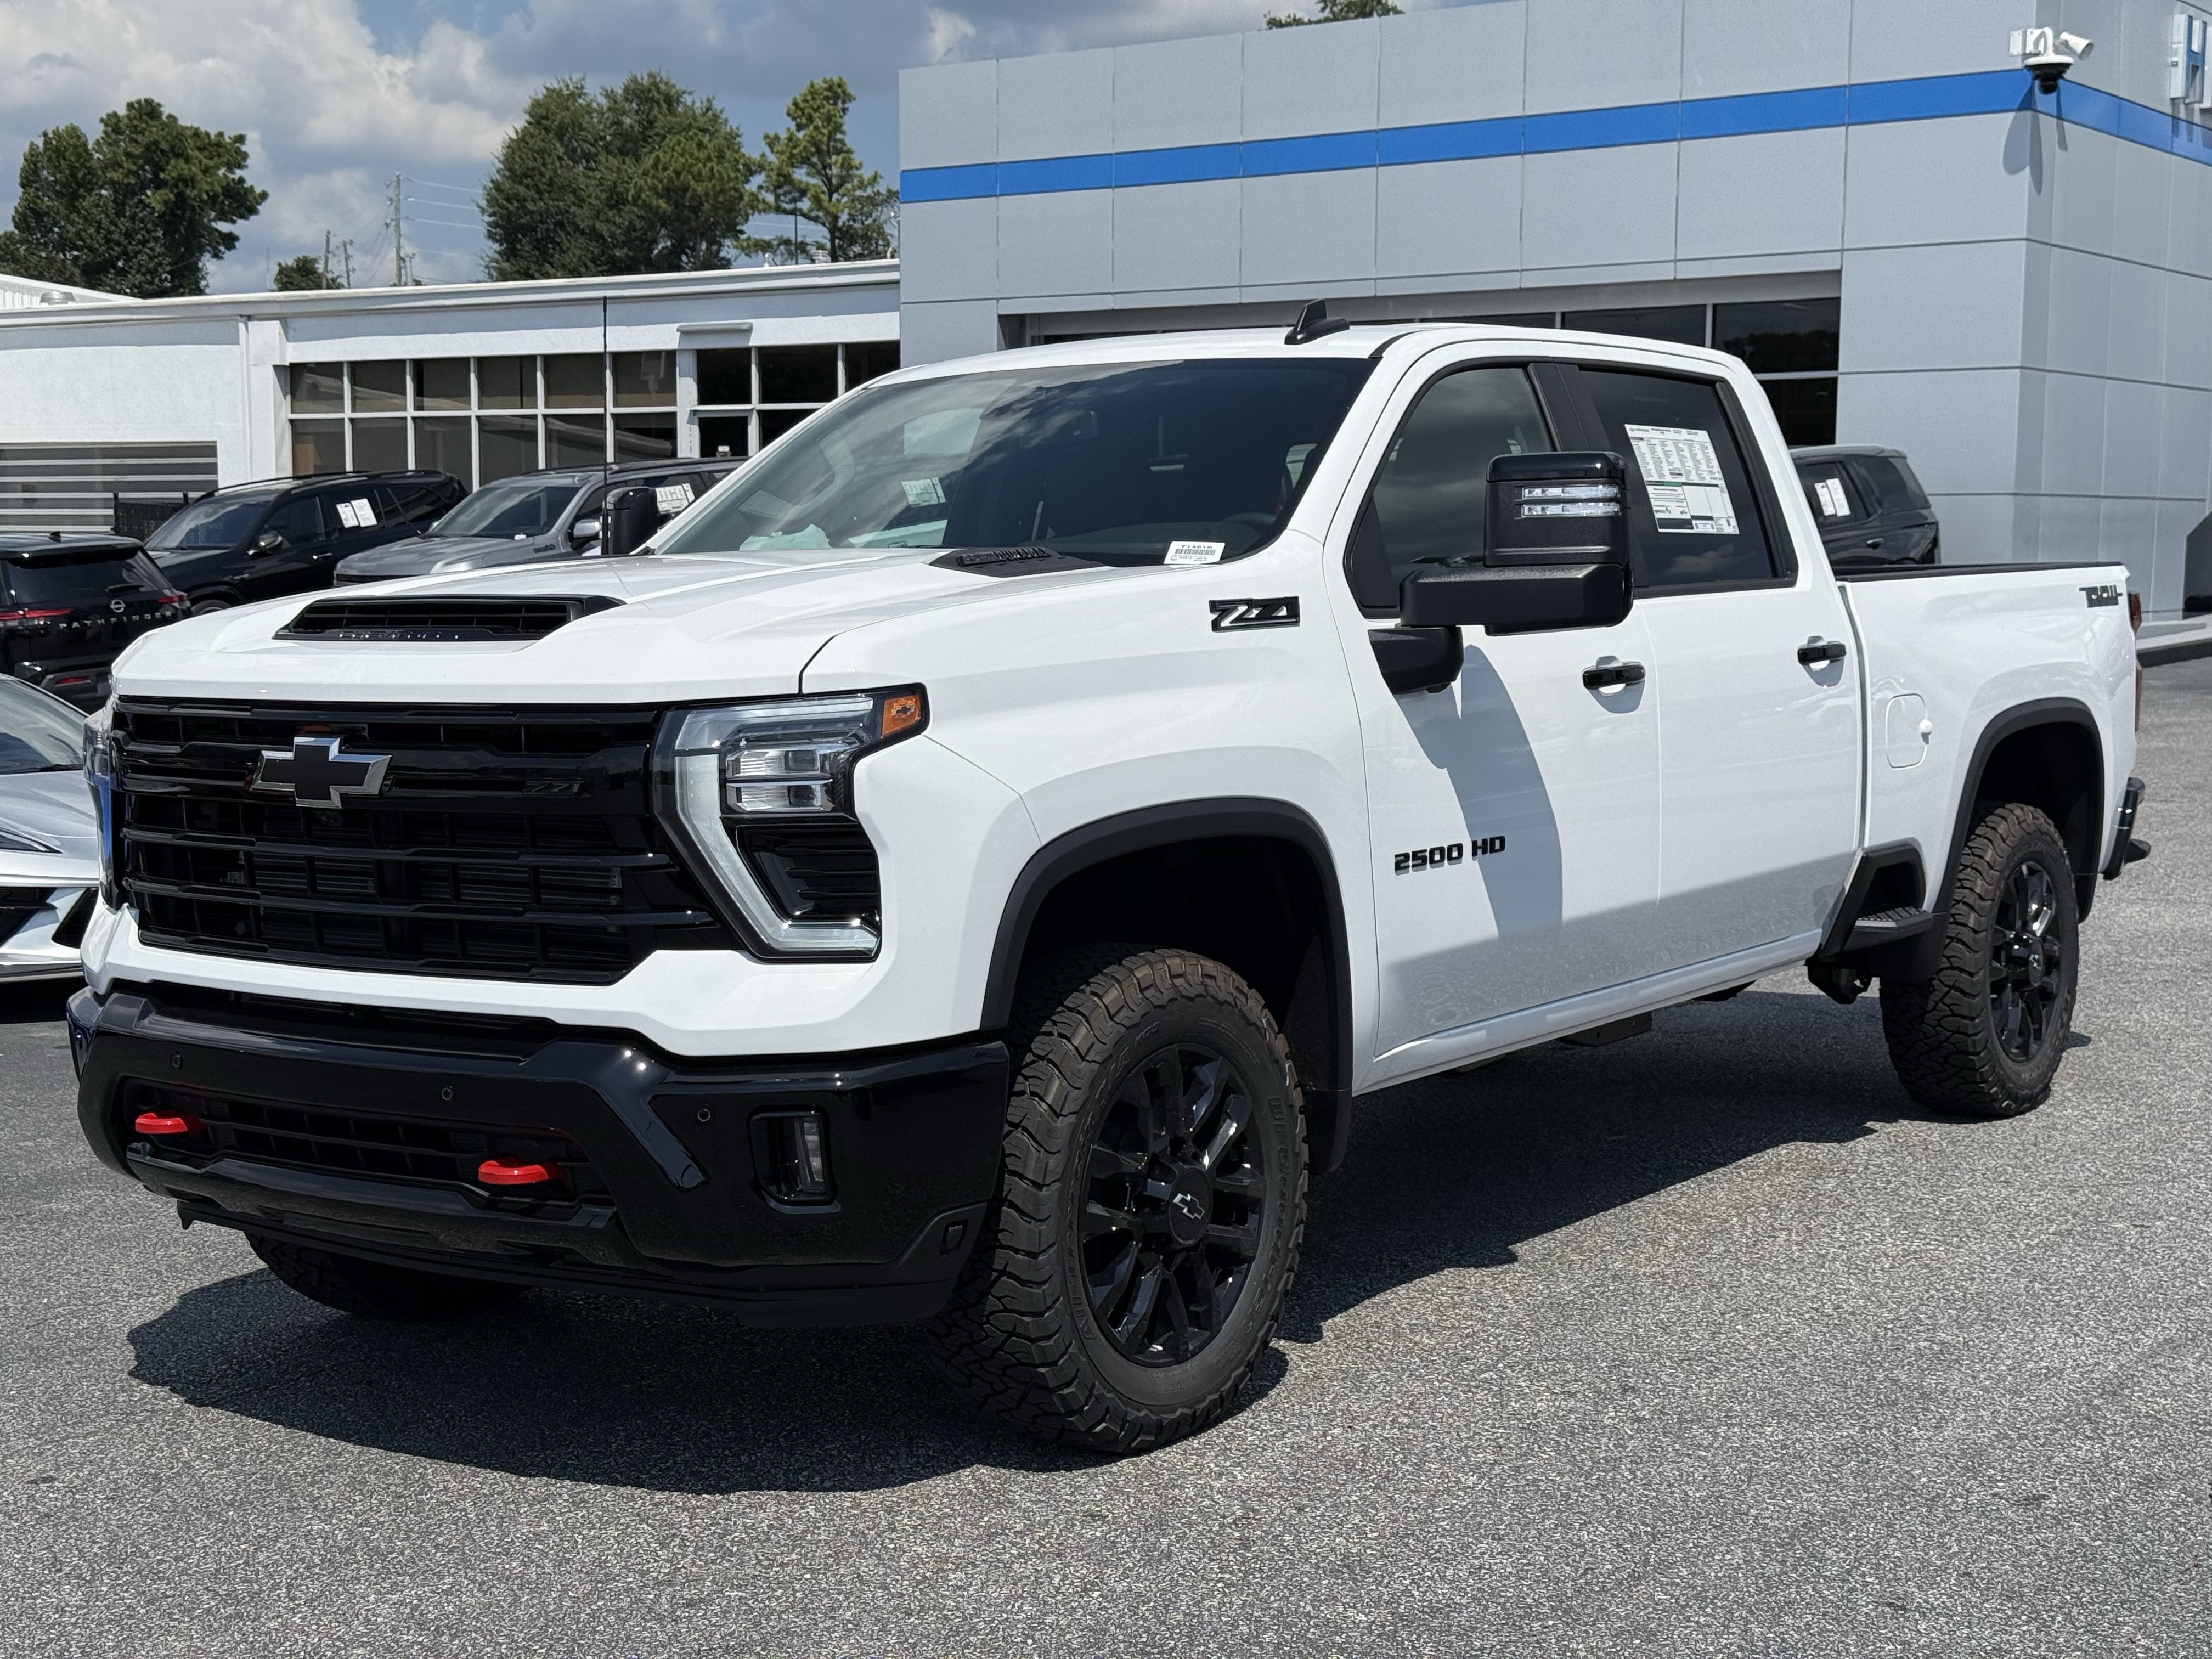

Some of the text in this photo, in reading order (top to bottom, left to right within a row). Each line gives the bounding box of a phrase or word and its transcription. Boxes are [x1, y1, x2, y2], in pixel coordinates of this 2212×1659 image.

[59, 611, 172, 630] PATHFINDER
[1209, 596, 1301, 633] Z71
[522, 780, 586, 798] Z71
[1395, 836, 1506, 872] 2500 HD
